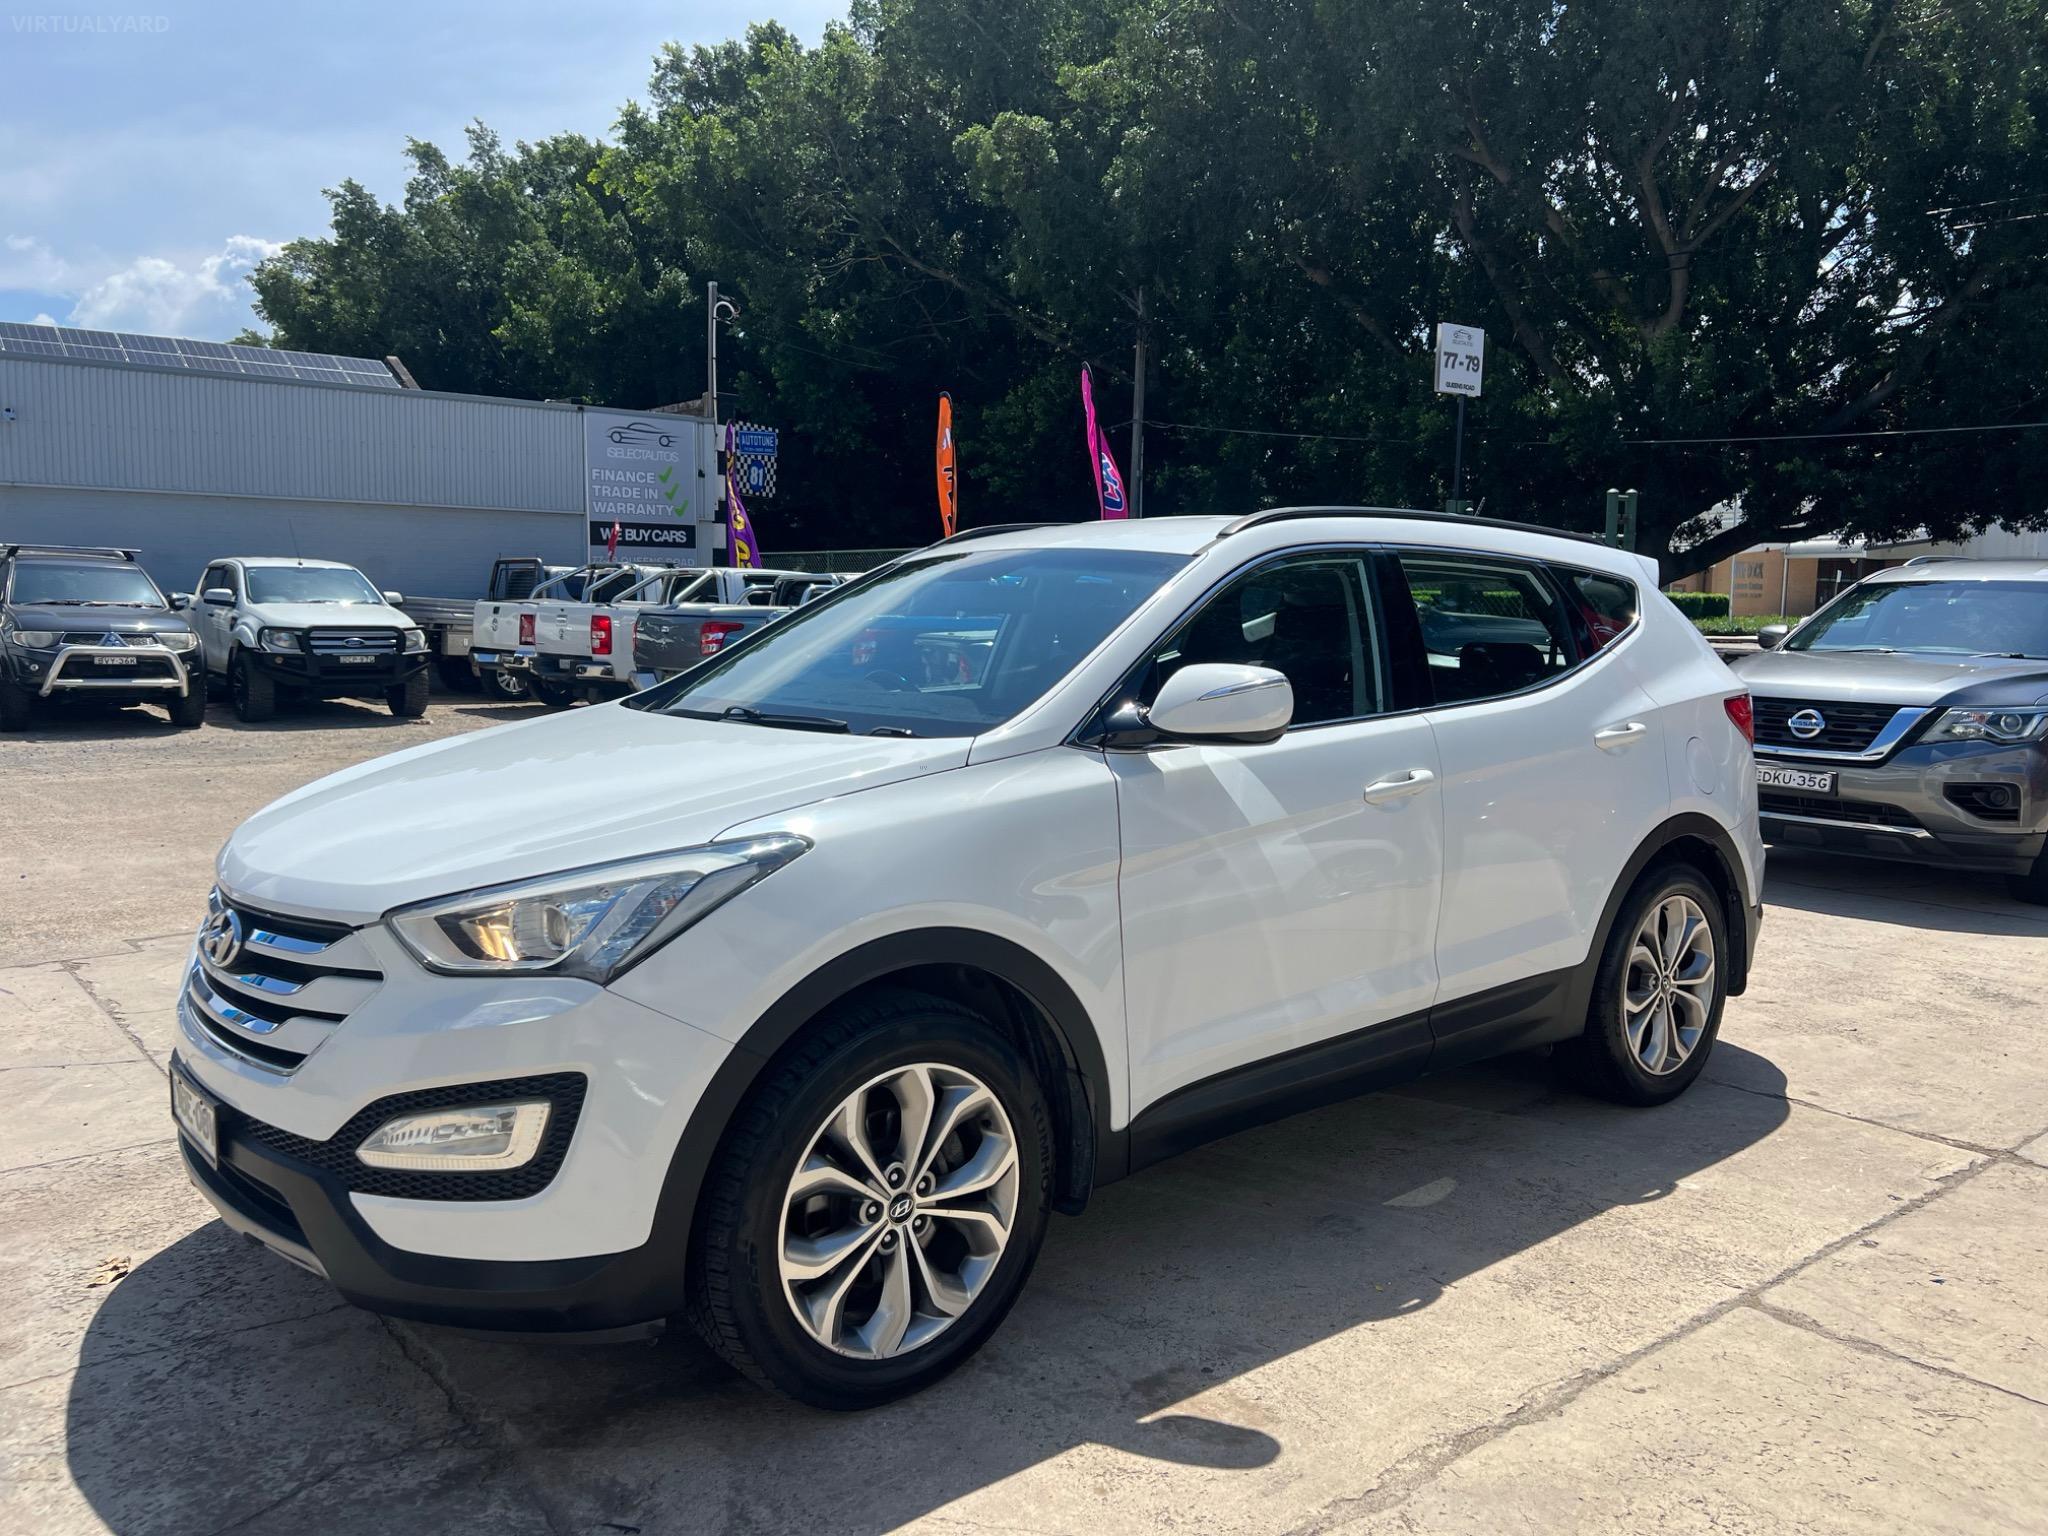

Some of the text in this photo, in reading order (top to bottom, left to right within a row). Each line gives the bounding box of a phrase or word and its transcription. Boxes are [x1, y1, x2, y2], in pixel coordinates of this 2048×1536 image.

[741, 434, 775, 447] AUTOTUNE
[591, 468, 656, 484] FINANCE
[749, 465, 764, 487] 81
[591, 485, 659, 500] TRADE IN
[592, 501, 675, 516] WARRANTY
[625, 528, 653, 542] BUY
[651, 530, 687, 544] CARS
[1030, 1102, 1050, 1192] KUMHO
